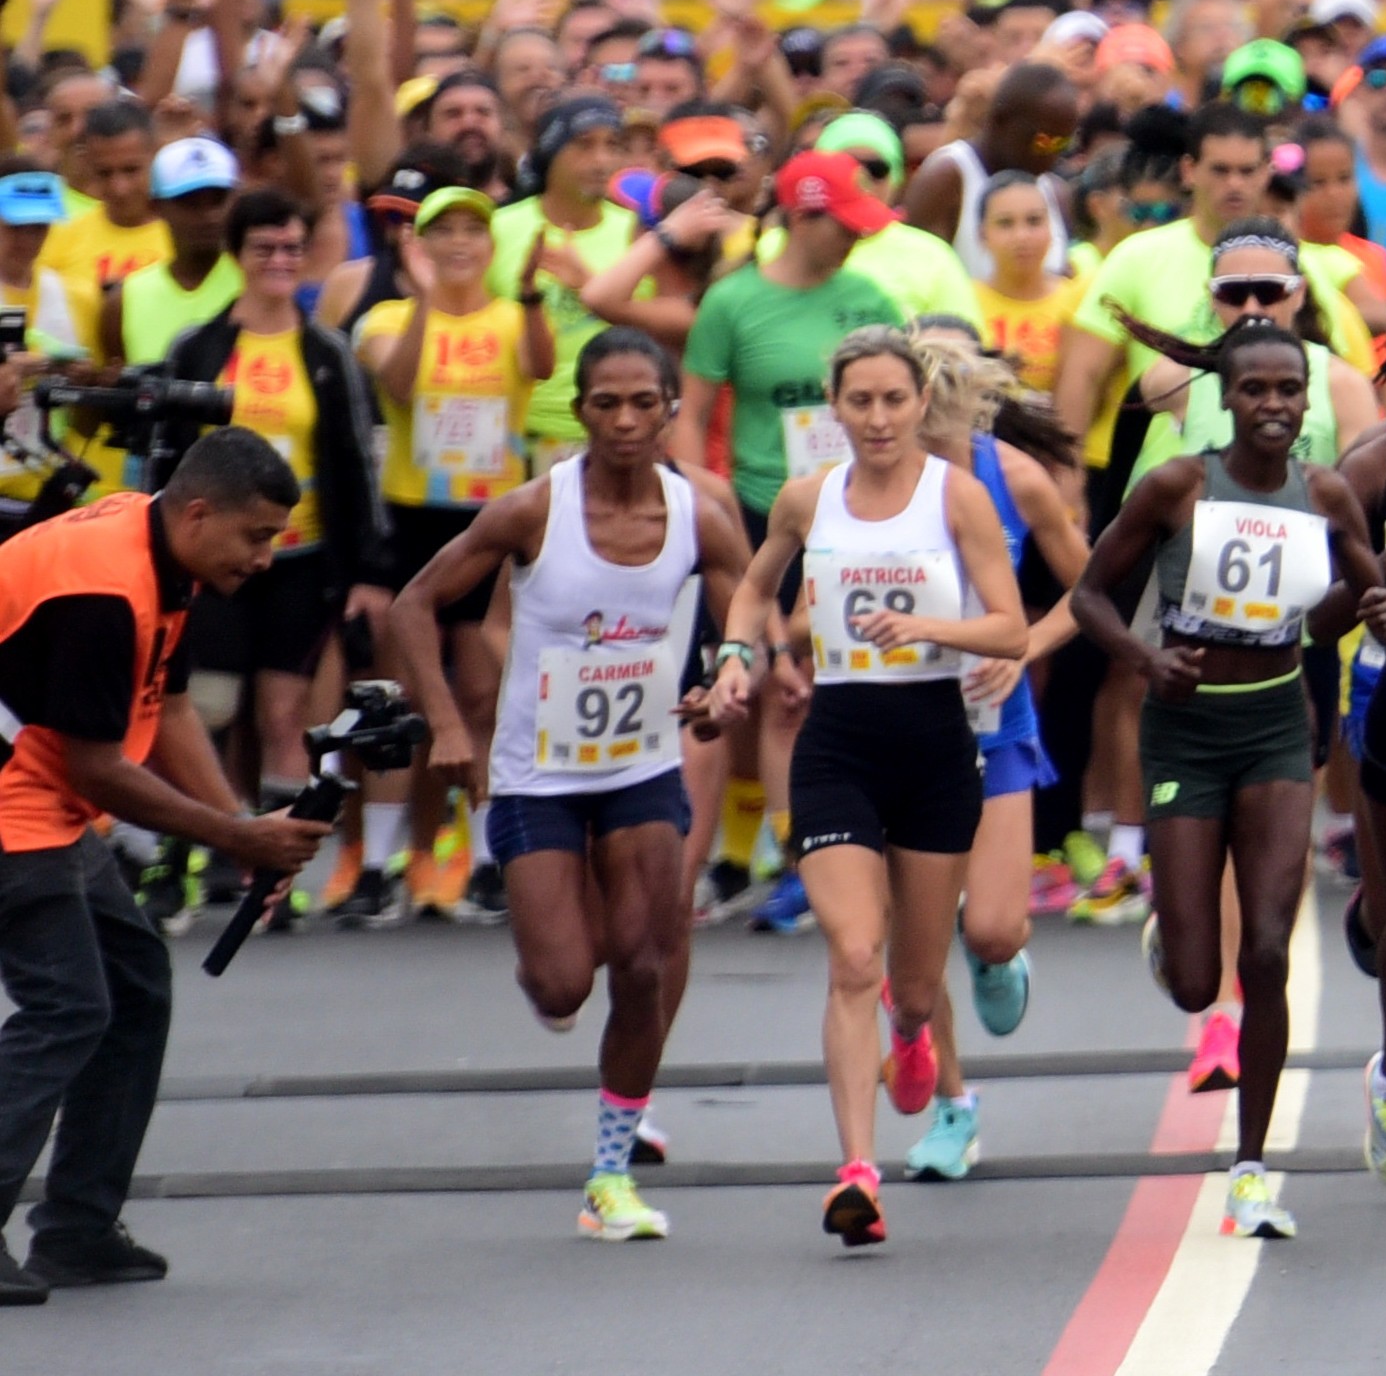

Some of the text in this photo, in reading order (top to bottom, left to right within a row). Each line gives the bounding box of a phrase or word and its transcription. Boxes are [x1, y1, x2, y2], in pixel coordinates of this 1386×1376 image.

[1235, 517, 1288, 539] VIOLA
[840, 567, 928, 586] PATRICIA
[1217, 538, 1284, 597] 61
[578, 659, 654, 682] CARMEM
[575, 682, 645, 738] 92
